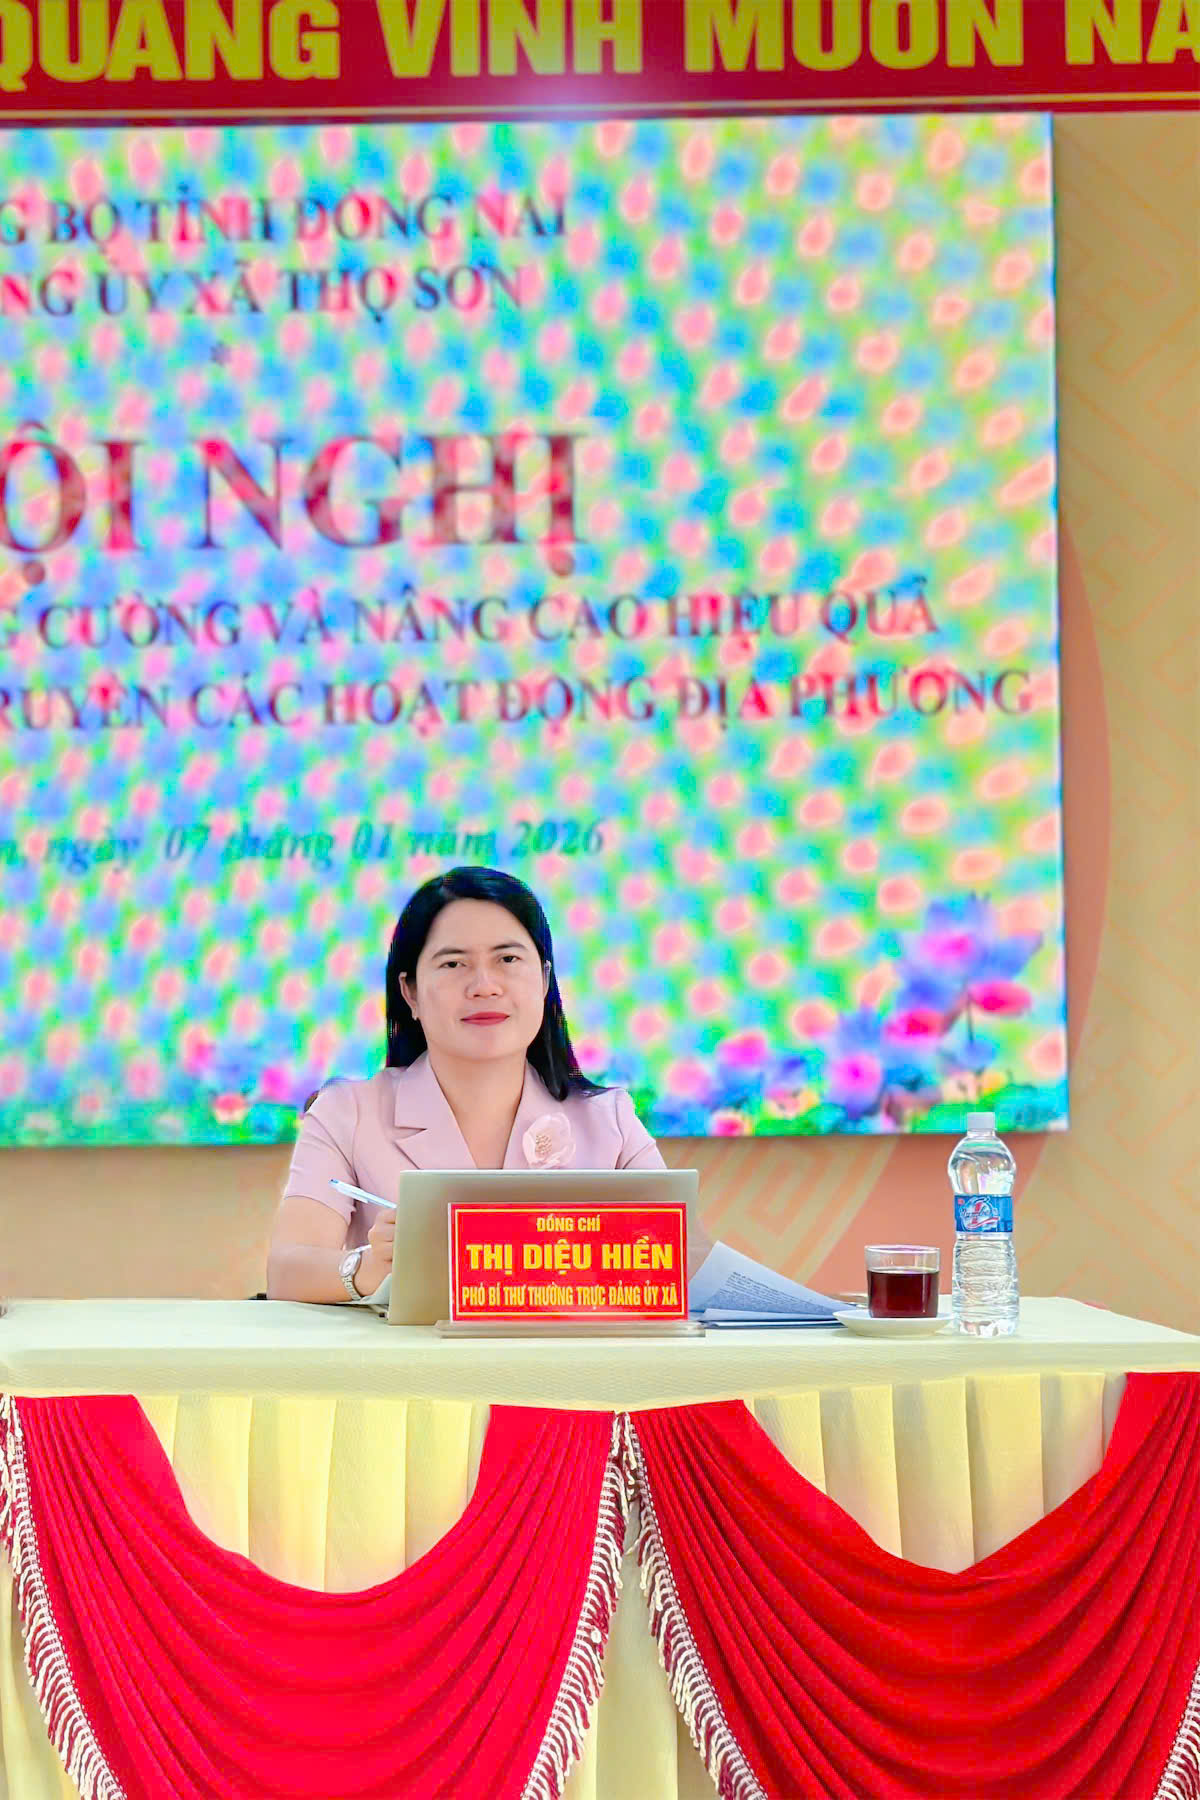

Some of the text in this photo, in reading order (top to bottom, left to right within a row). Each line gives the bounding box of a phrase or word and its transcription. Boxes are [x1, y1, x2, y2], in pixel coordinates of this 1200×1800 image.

[373, 0, 643, 77] VINH
[471, 195, 566, 238] NAI
[189, 259, 263, 314] XÃ
[281, 266, 402, 323] THỌ
[414, 262, 526, 312] SƠN
[194, 431, 588, 578] NGHỊ
[254, 587, 336, 644] VÀ
[350, 581, 511, 643] NÂNG
[529, 594, 650, 641] CAO
[666, 587, 804, 651] HIỆU
[820, 574, 941, 645] QUẢ
[189, 673, 303, 729] CÁC
[320, 677, 482, 737] HOẠT
[678, 675, 776, 732] ĐỊA
[790, 666, 1034, 719] PHƯƠNG
[166, 824, 211, 862] 07
[353, 821, 394, 860] 01
[511, 818, 606, 859] 2026
[577, 1214, 601, 1232] CHÍ
[466, 1235, 673, 1275] THỊ DIỆU HIỀN
[462, 1280, 678, 1310] PHÓ BÍ THƯ THƯỜNG TRỰC ĐẢNG ỦY XÃ
